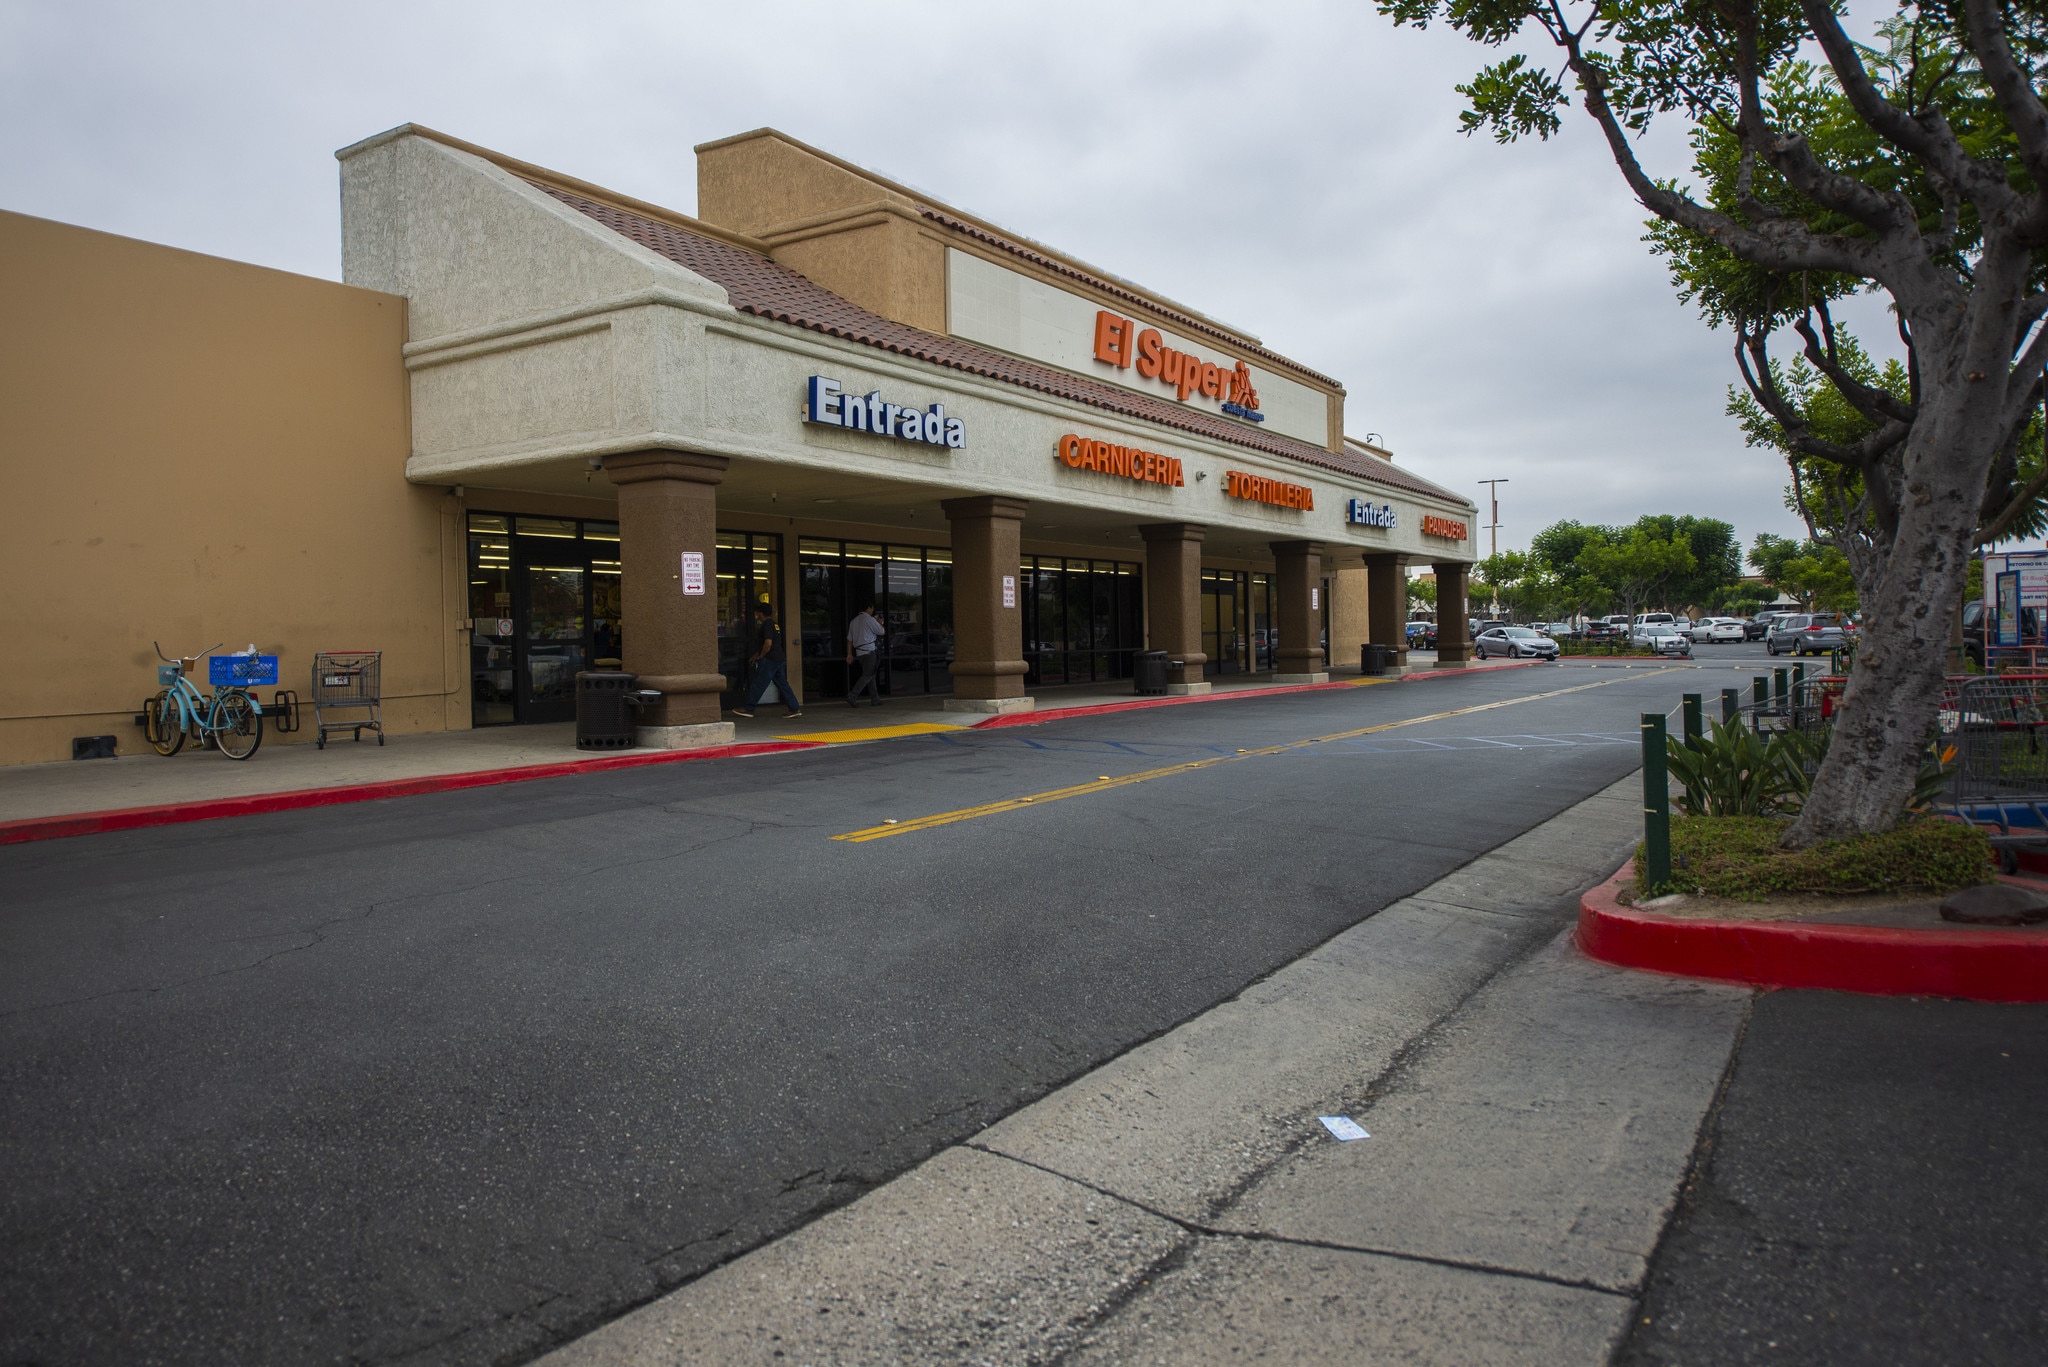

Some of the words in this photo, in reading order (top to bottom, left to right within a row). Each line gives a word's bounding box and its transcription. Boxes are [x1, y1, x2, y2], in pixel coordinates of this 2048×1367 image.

[1094, 310, 1134, 368] El
[1136, 328, 1232, 400] Super
[809, 375, 966, 449] Entrada
[1059, 434, 1185, 487] CARNICERIA
[1226, 471, 1314, 511] TORTILLERIA
[1350, 499, 1397, 529] Entrada
[1425, 516, 1467, 541] PANADERIA
